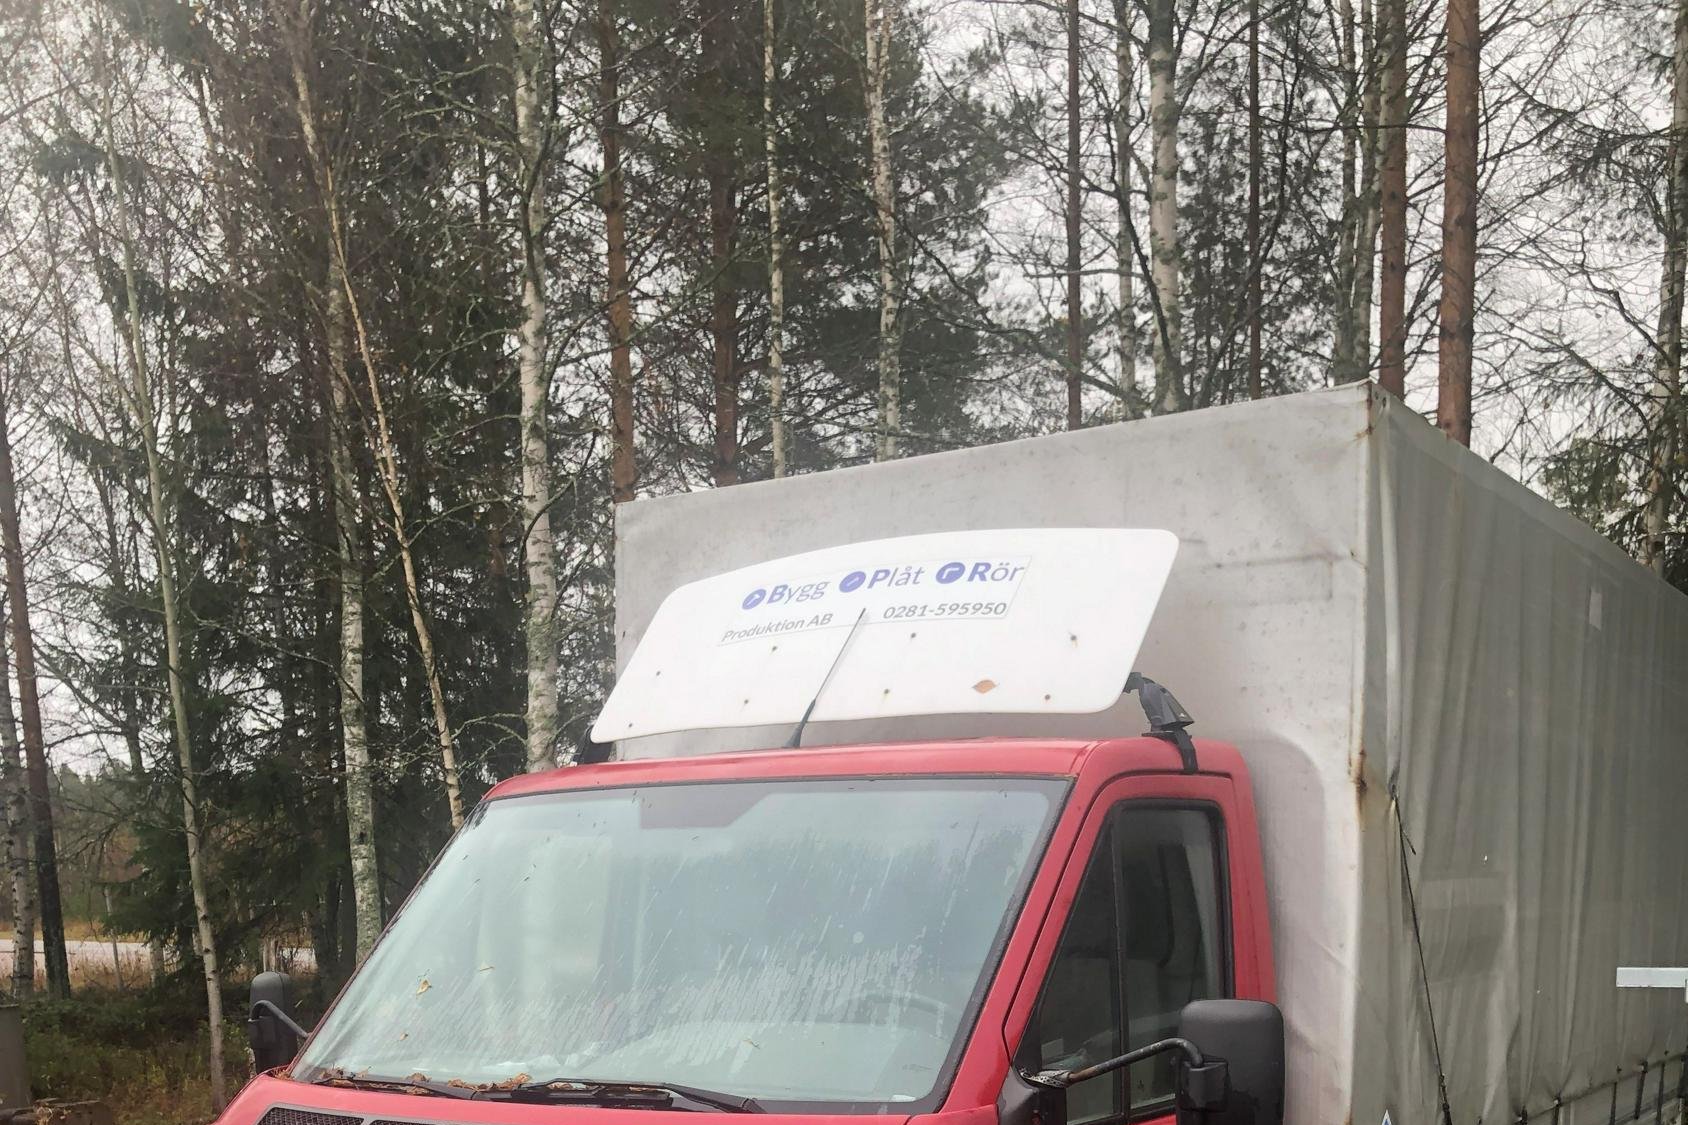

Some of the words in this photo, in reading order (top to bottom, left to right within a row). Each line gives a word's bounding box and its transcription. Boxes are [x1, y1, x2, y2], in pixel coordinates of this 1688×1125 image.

[766, 581, 830, 605] Bygg
[867, 566, 925, 589] Plåt
[967, 562, 1025, 583] Rör
[882, 602, 1007, 619] 0281-595950
[721, 615, 805, 642] Produktion
[809, 612, 834, 627] AB
